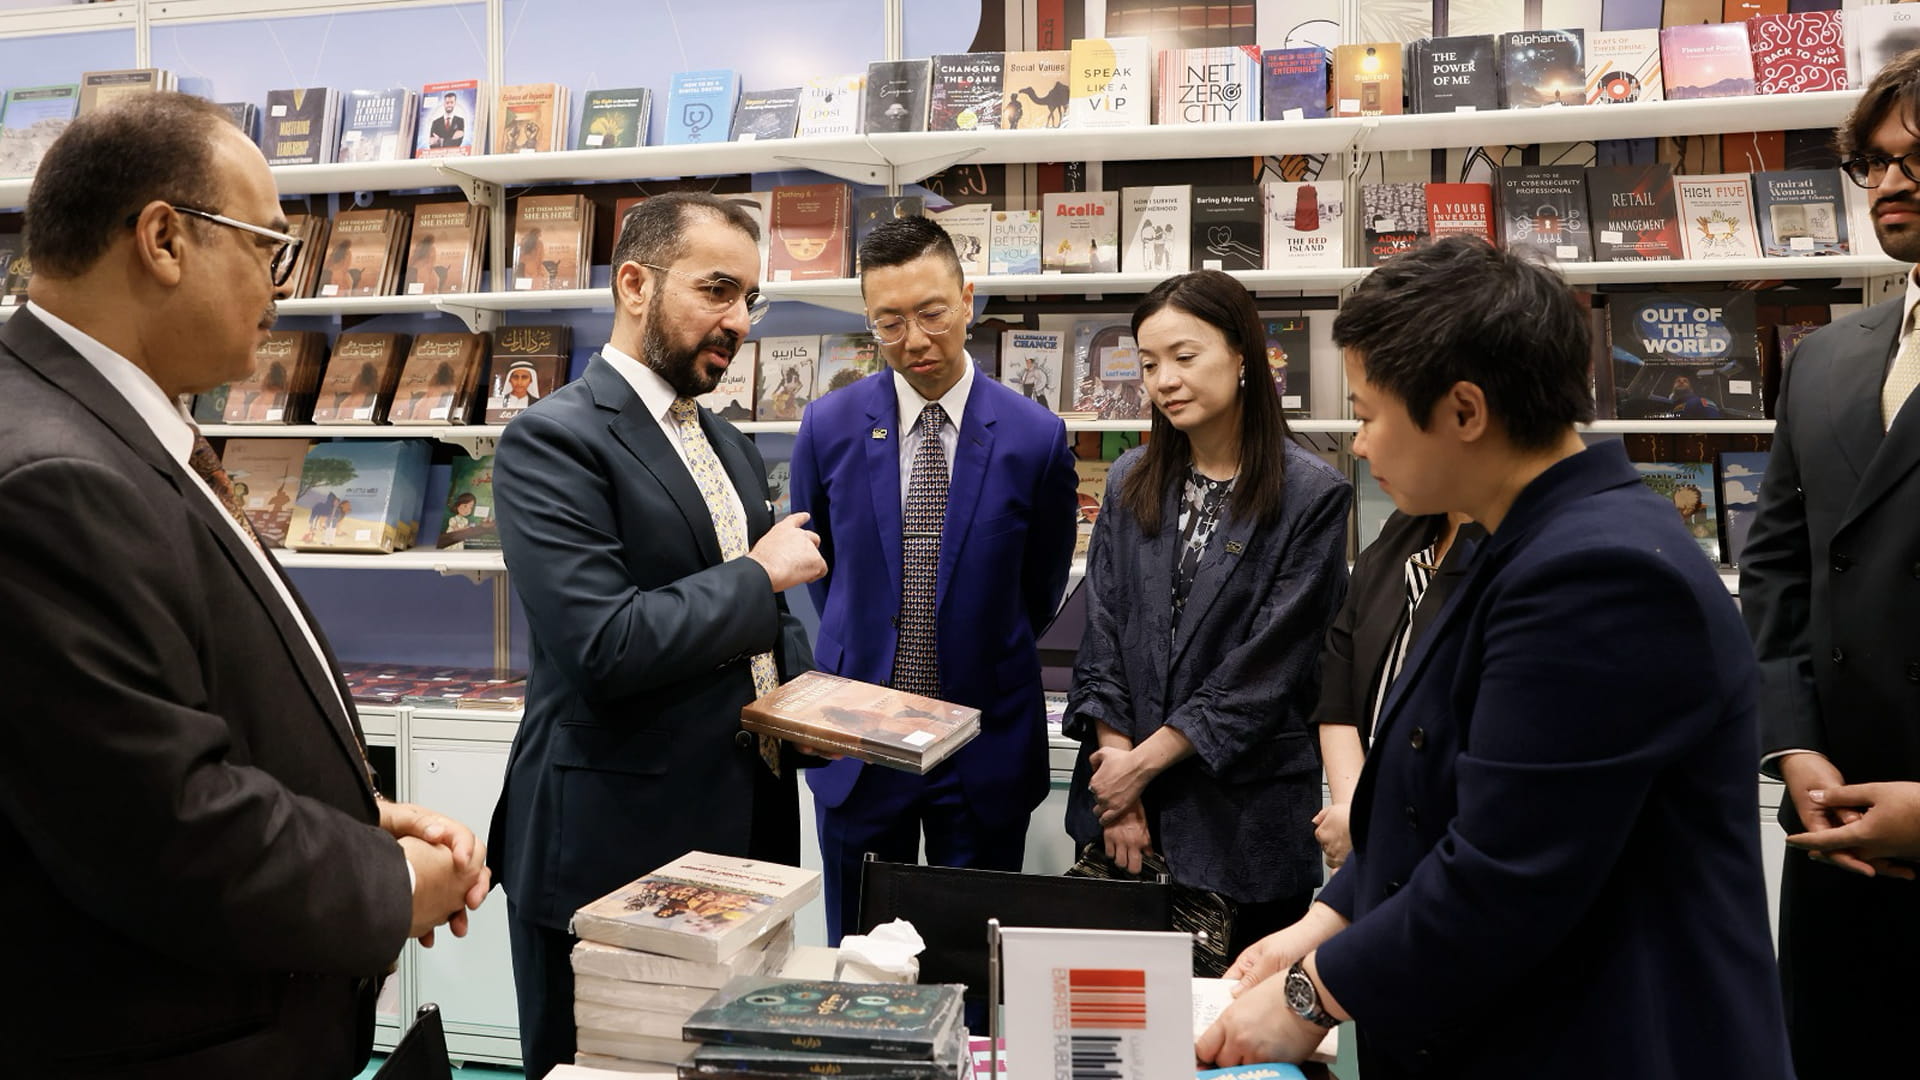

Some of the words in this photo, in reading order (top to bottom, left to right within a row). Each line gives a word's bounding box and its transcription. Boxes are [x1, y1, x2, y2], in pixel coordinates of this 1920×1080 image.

[1432, 52, 1457, 62] THE
[1764, 47, 1793, 65] BACK
[1796, 48, 1810, 59] TO
[1813, 54, 1841, 65] THAT
[941, 65, 1001, 73] CHANGING
[1010, 63, 1035, 72] Social
[1038, 63, 1065, 72] Values
[1187, 63, 1236, 83] NET
[1433, 62, 1476, 74] POWER
[1084, 68, 1132, 79] SPEAK
[1433, 76, 1451, 86] OF
[1452, 75, 1471, 85] ME
[1087, 84, 1114, 92] LIKE
[1178, 83, 1242, 103] ZERO
[1184, 103, 1238, 123] CITY
[1521, 179, 1580, 187] CYBERSECURITY
[1768, 179, 1813, 188] Emirati
[1684, 187, 1712, 198] HIGH
[1715, 186, 1745, 198] FIVE
[1612, 192, 1656, 207] RETAIL
[1433, 204, 1439, 213] A
[1446, 203, 1485, 213] YOUNG
[995, 224, 1027, 235] BUILD
[1608, 219, 1665, 231] MANAGEMENT
[994, 236, 1038, 247] BETTER
[1378, 234, 1416, 242] ADMAN
[1392, 241, 1411, 249] VS.
[1002, 248, 1028, 259] YOU
[1642, 308, 1688, 323] OUT
[1692, 307, 1723, 322] OF
[1658, 323, 1708, 337] THIS
[1013, 341, 1057, 350] CHANCE
[1642, 339, 1727, 354] WORLD
[772, 346, 807, 361] كاريبو
[1052, 968, 1068, 1030] EMIRATES
